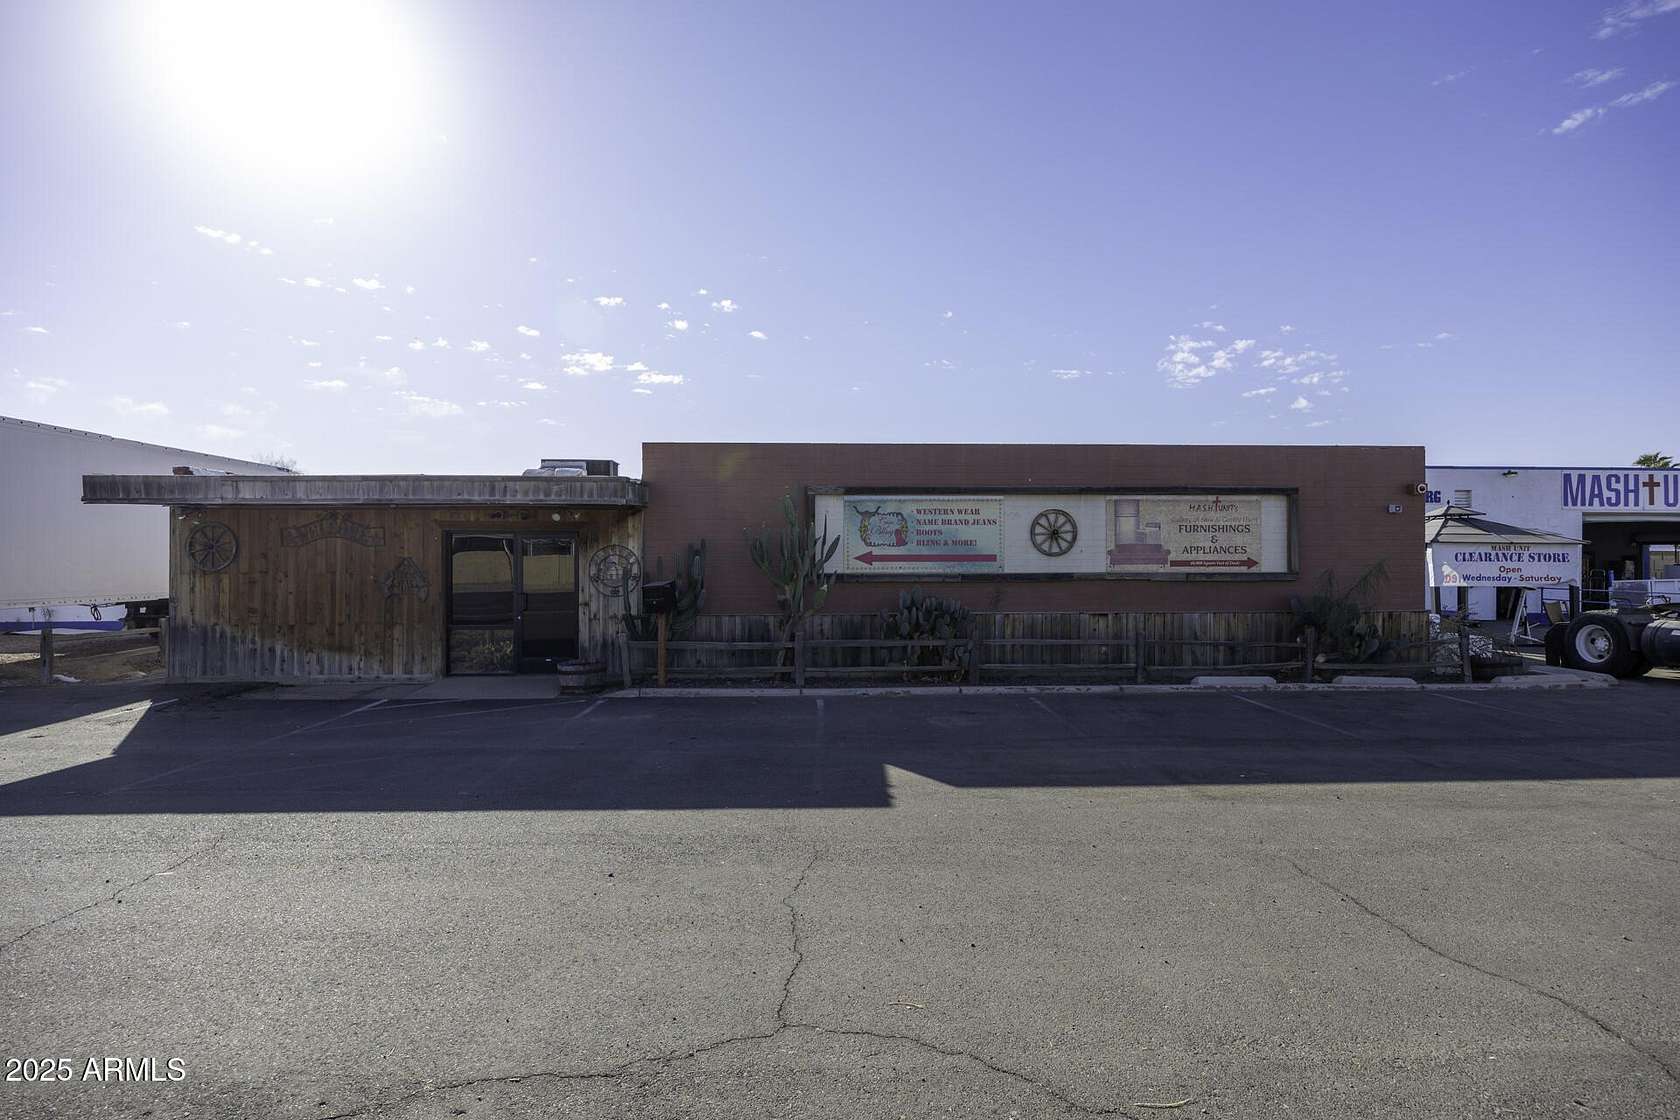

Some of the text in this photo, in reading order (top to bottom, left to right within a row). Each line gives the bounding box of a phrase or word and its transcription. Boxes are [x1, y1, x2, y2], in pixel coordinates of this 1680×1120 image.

[915, 508, 980, 516] WESTERN WEAR
[915, 518, 998, 526] NAME BRAND JEANS
[916, 528, 943, 536] BOOTS
[1178, 524, 1251, 534] FURNISHINGS
[916, 539, 940, 547] BLING
[951, 539, 977, 547] MORE!
[1210, 534, 1218, 544] &
[1182, 545, 1248, 555] APPLIANCES
[1491, 544, 1531, 552] MASH UNIT
[1454, 551, 1570, 563] CLEARANCE STORE
[1498, 565, 1522, 574] Open
[1462, 573, 1513, 583] Wednesday
[1519, 574, 1562, 583] Saturday
